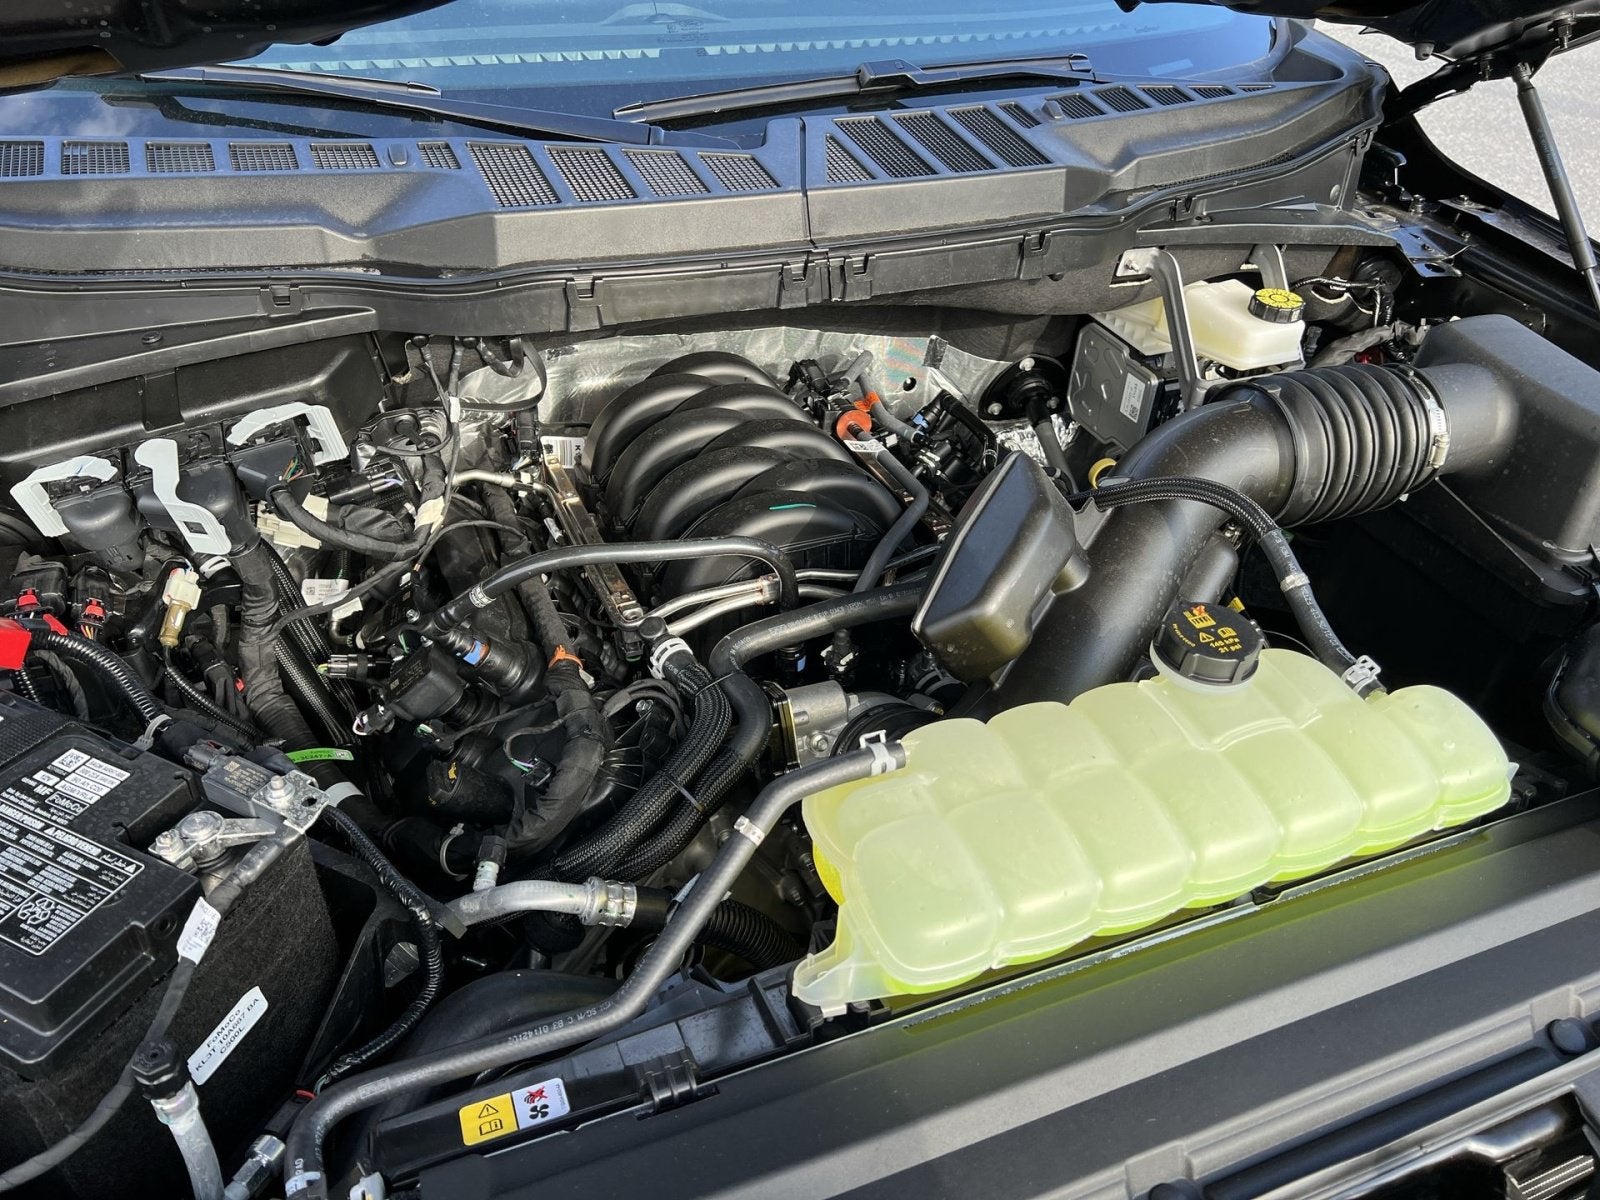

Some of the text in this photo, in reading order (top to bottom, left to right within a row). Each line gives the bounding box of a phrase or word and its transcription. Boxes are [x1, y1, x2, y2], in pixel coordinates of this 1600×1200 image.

[1219, 646, 1230, 654] 21
[52, 794, 84, 813] FoMoCo
[206, 1009, 241, 1048] FoMoCo
